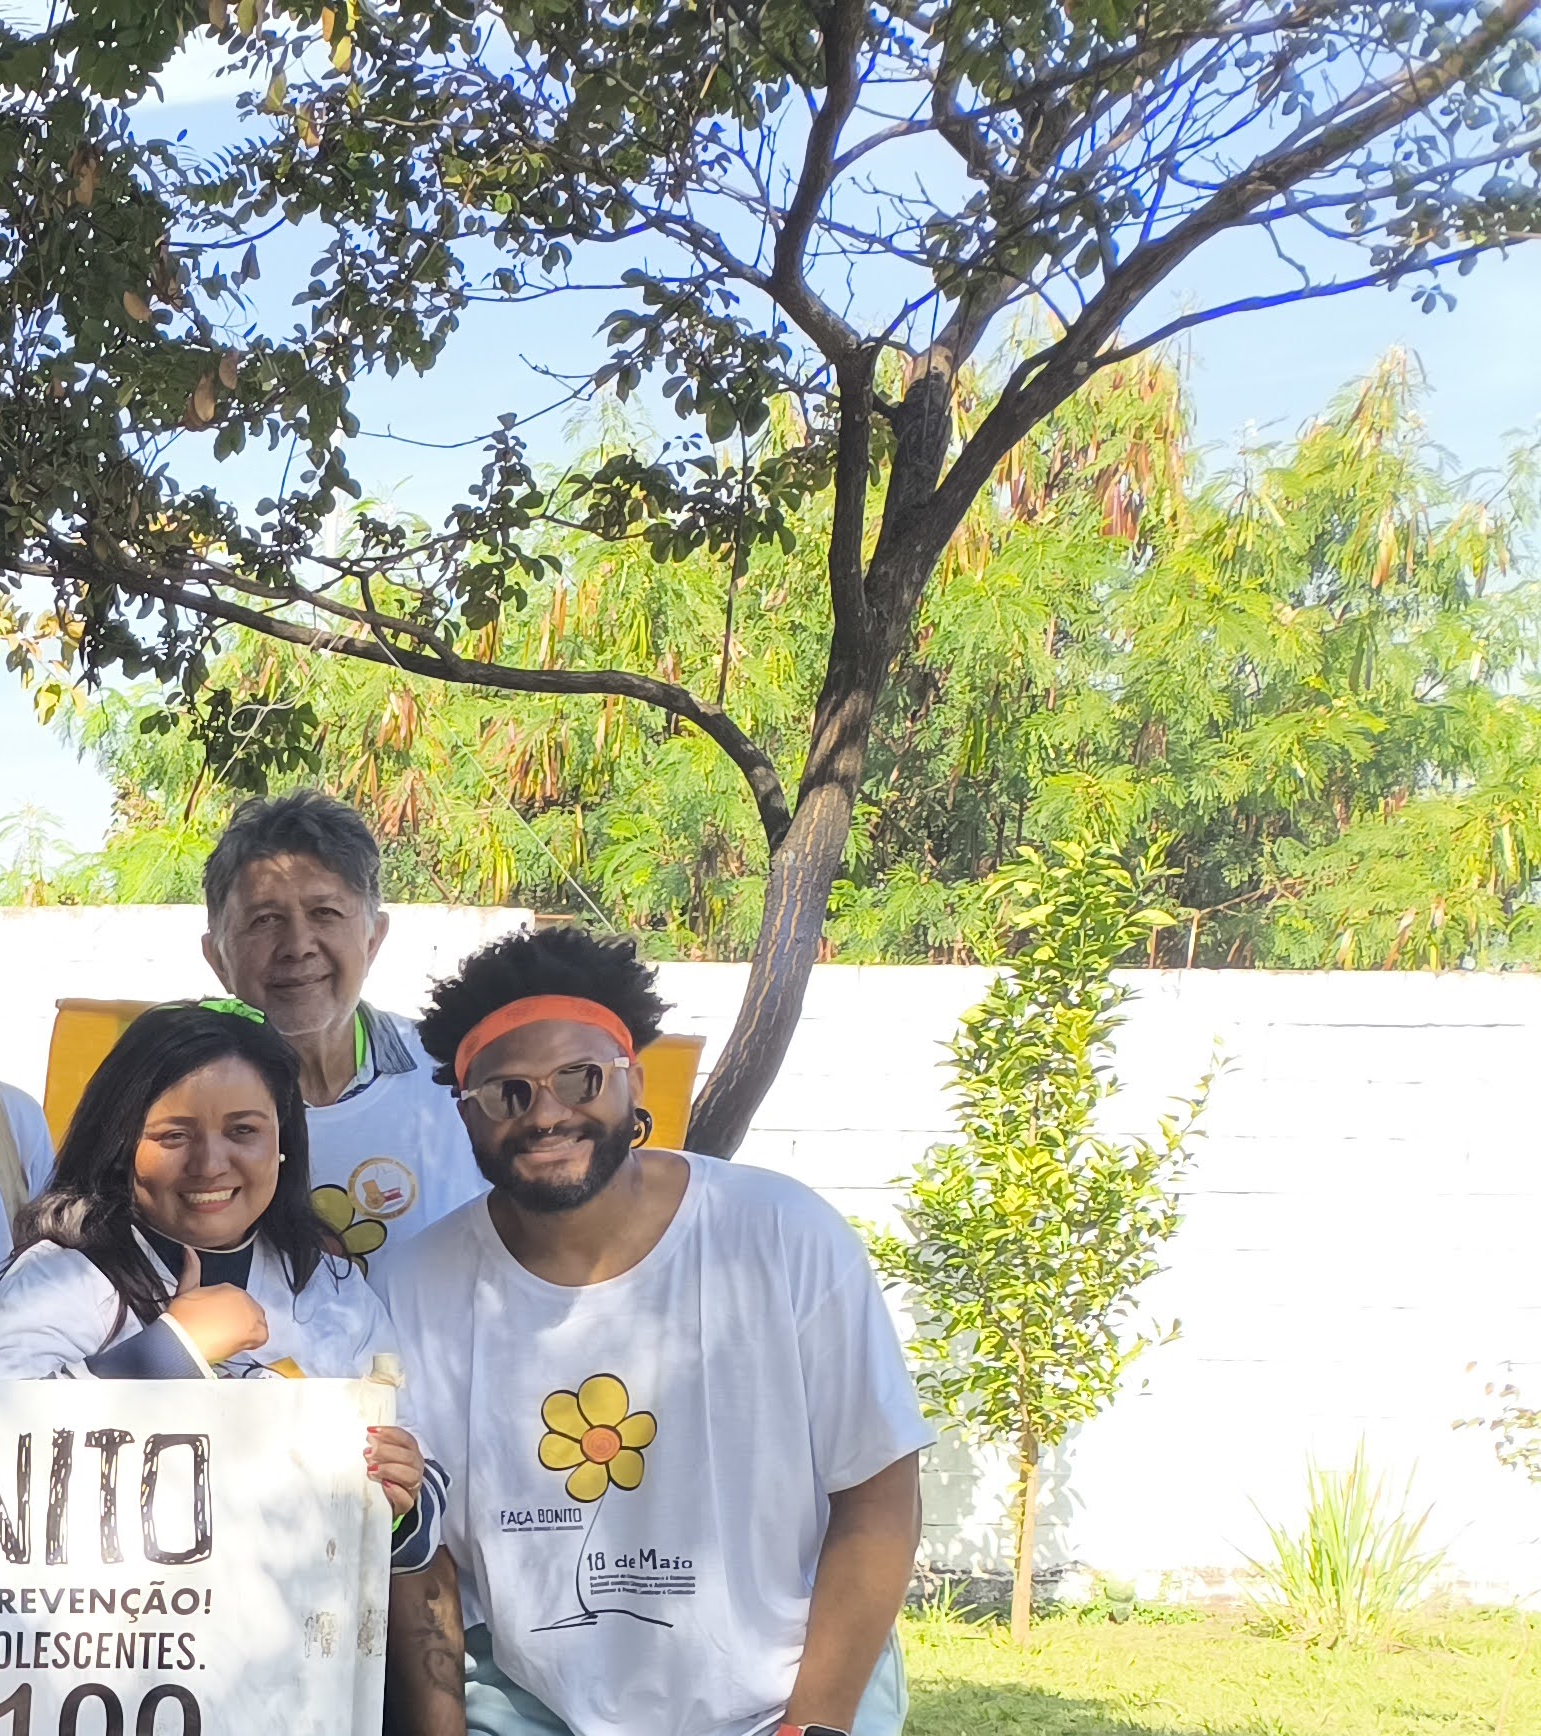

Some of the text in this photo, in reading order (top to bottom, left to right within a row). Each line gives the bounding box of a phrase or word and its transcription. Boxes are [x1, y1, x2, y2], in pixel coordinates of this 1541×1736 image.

[500, 1508, 582, 1526] FAÇA BONITO
[586, 1548, 693, 1571] 18 de Maio
